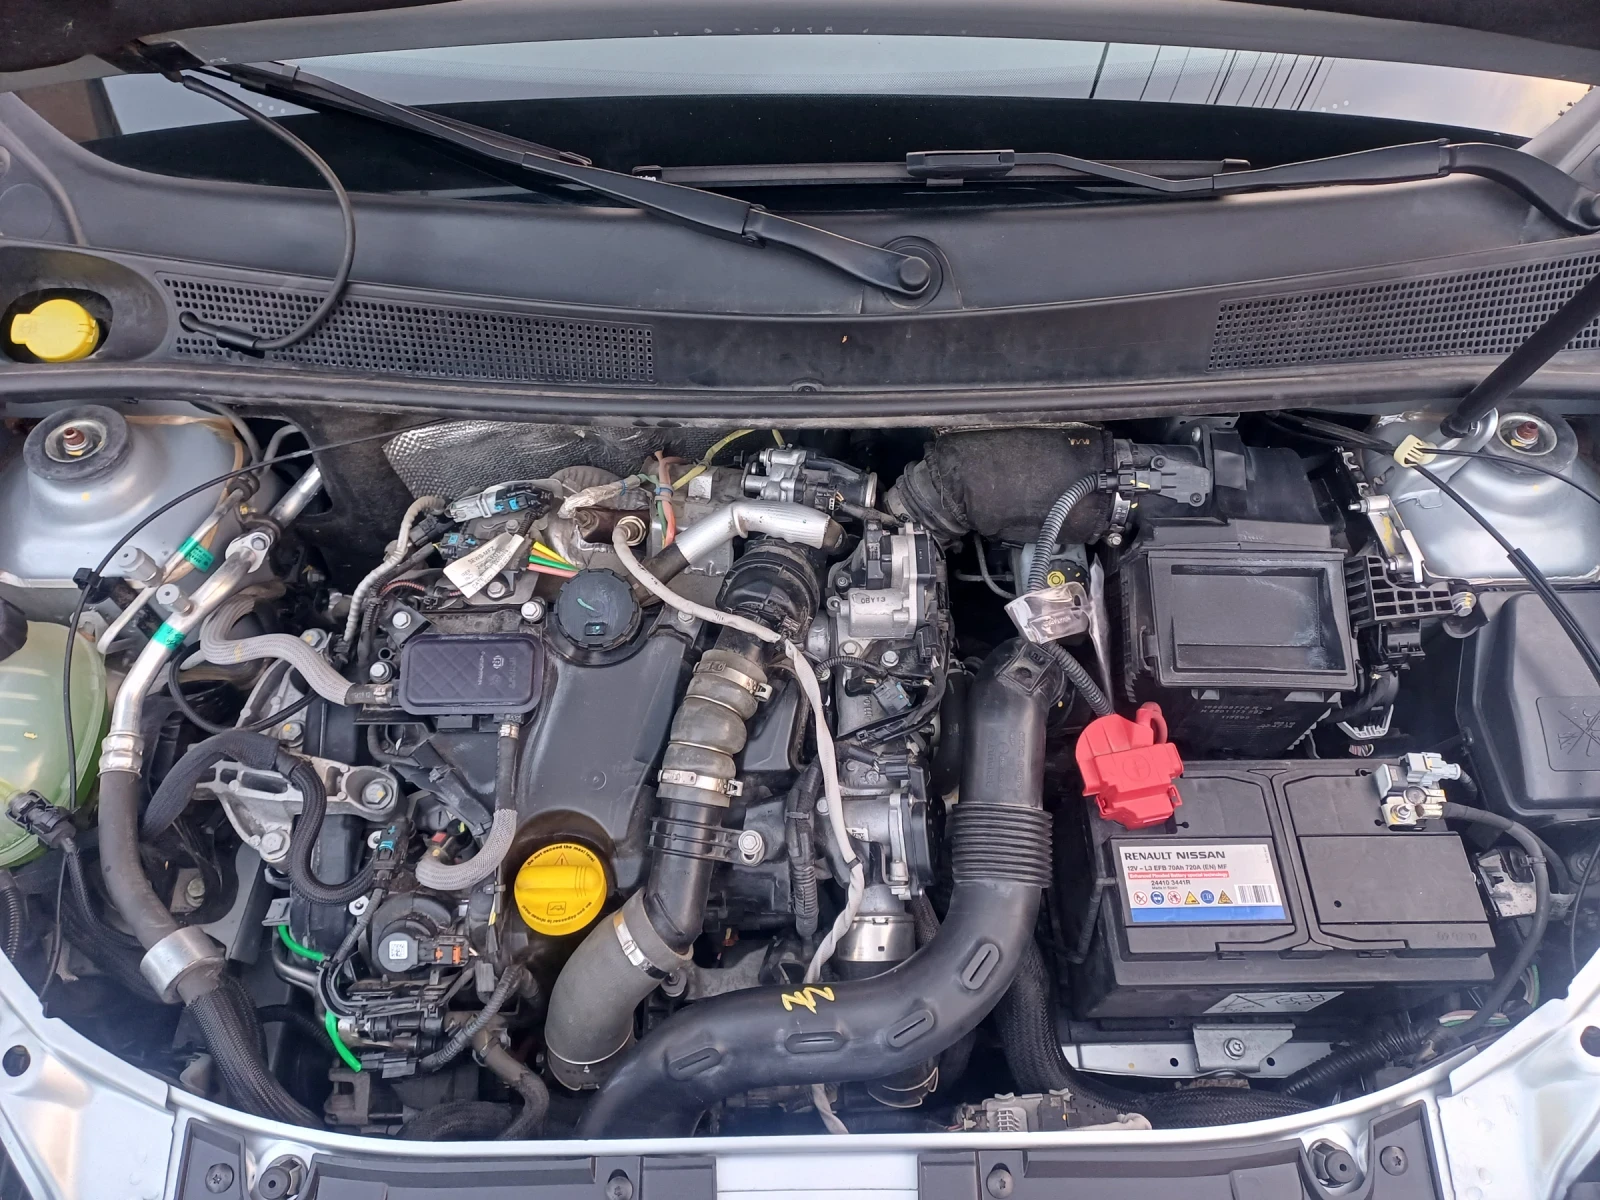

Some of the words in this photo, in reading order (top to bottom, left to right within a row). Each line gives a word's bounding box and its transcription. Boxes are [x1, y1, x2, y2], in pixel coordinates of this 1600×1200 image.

[534, 852, 543, 860] not
[1124, 851, 1172, 860] RENAULT
[1176, 851, 1226, 860] NISSAN
